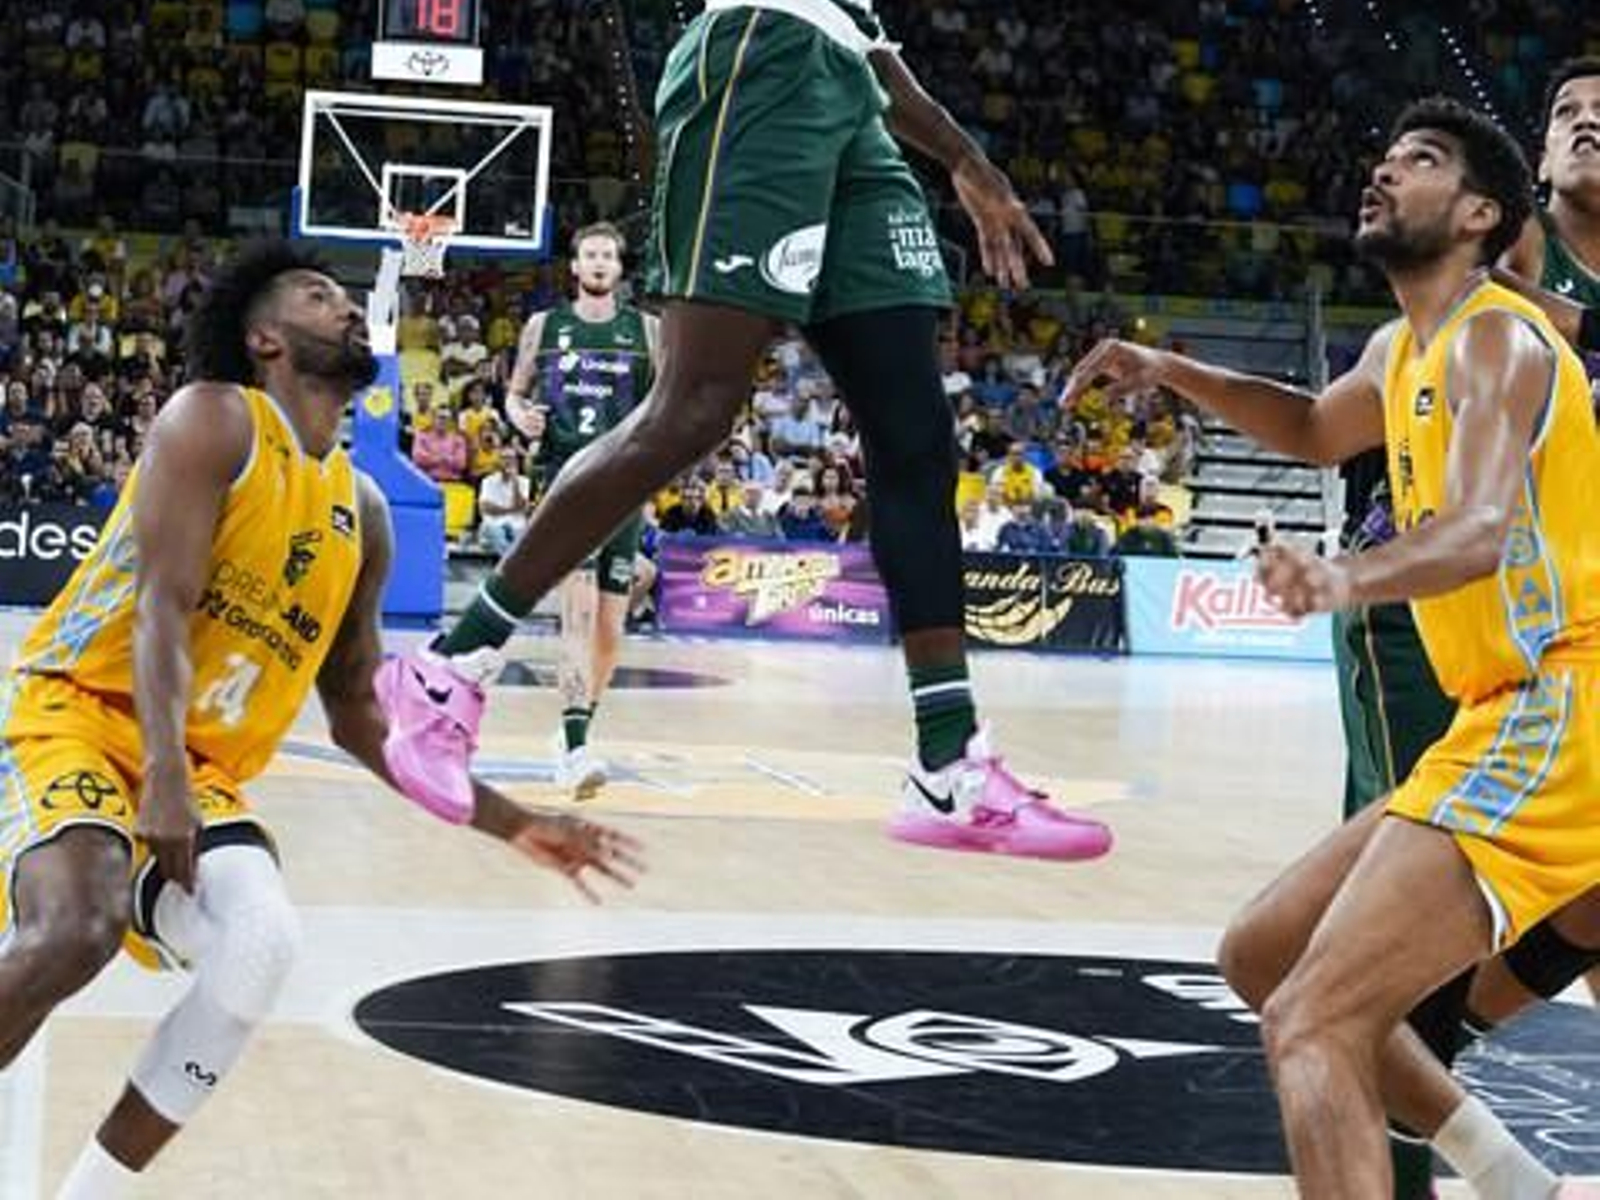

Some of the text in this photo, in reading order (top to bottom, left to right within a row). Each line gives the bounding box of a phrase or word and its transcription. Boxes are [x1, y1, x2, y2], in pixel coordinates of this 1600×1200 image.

[578, 407, 597, 434] 2
[0, 511, 99, 560] des
[1050, 562, 1120, 597] Bus
